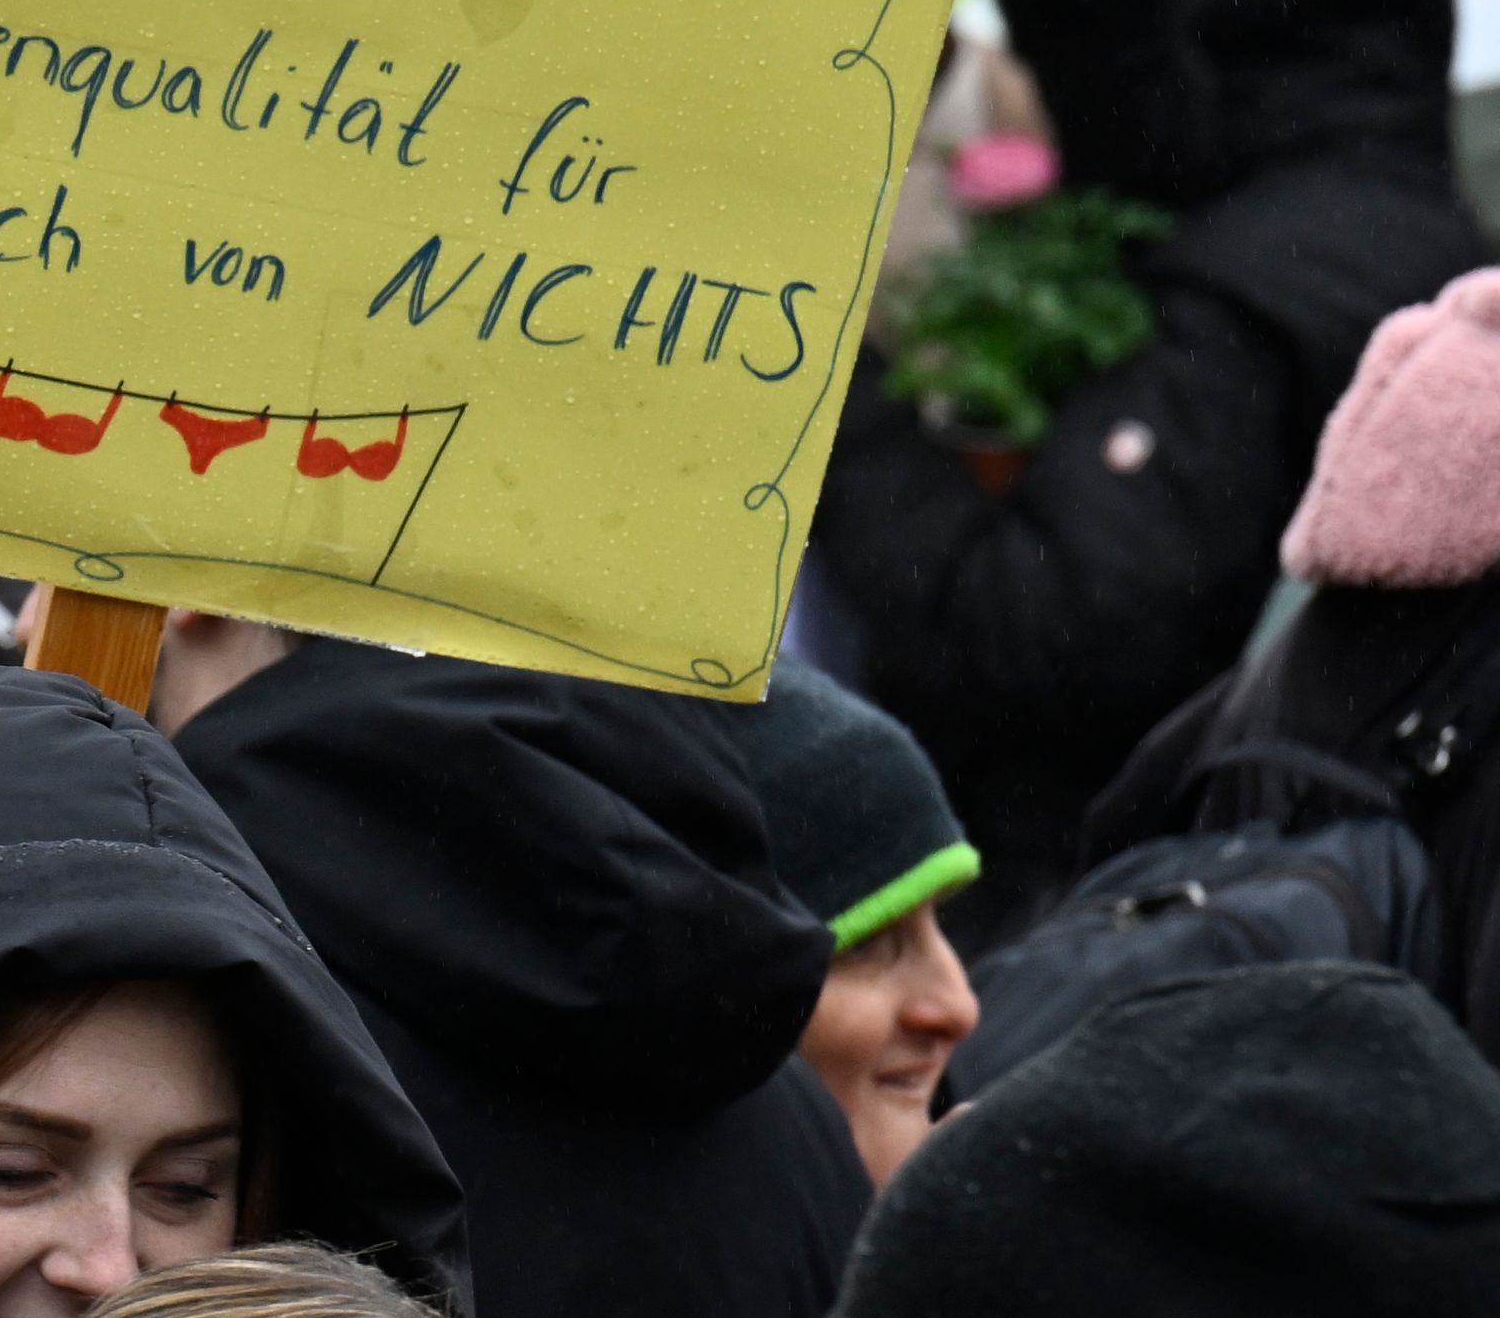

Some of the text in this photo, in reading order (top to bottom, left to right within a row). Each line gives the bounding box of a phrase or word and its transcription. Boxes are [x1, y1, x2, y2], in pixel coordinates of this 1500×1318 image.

[499, 97, 638, 216] für
[184, 238, 287, 302] von
[367, 235, 818, 383] NICHTS
